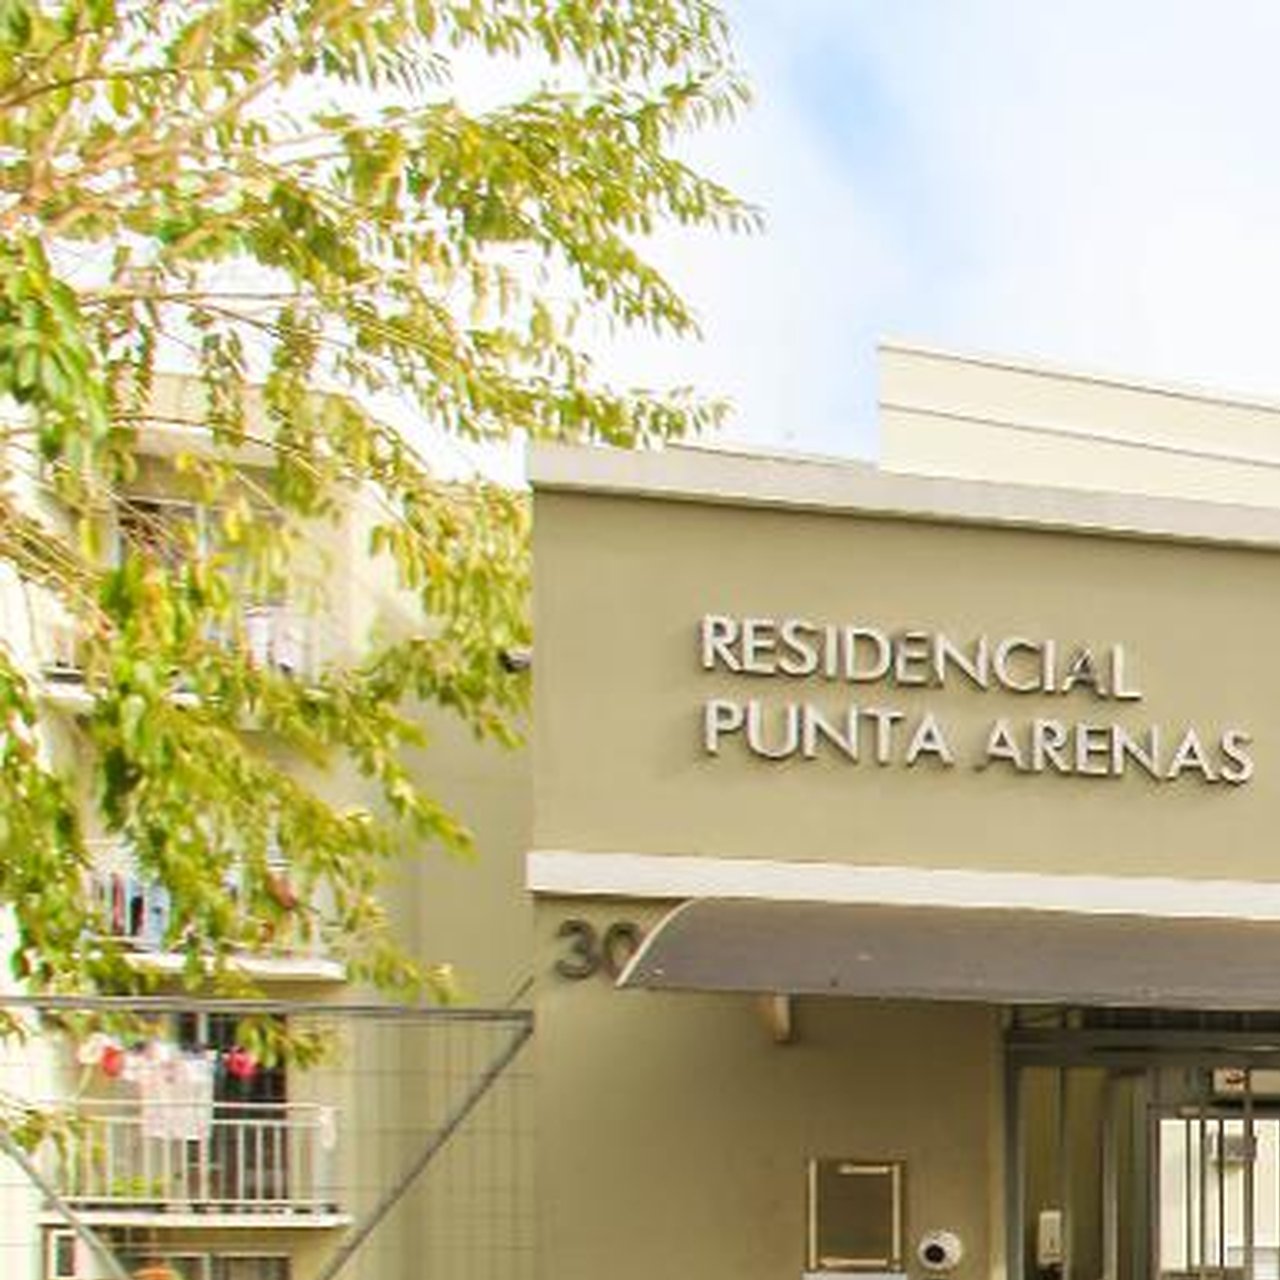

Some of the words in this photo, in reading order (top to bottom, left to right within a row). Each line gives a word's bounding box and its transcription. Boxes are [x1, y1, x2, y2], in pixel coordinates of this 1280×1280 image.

[700, 614, 1144, 700] RESIDENCIAL
[703, 698, 955, 768] PUNTA
[974, 716, 1257, 784] ARENAS
